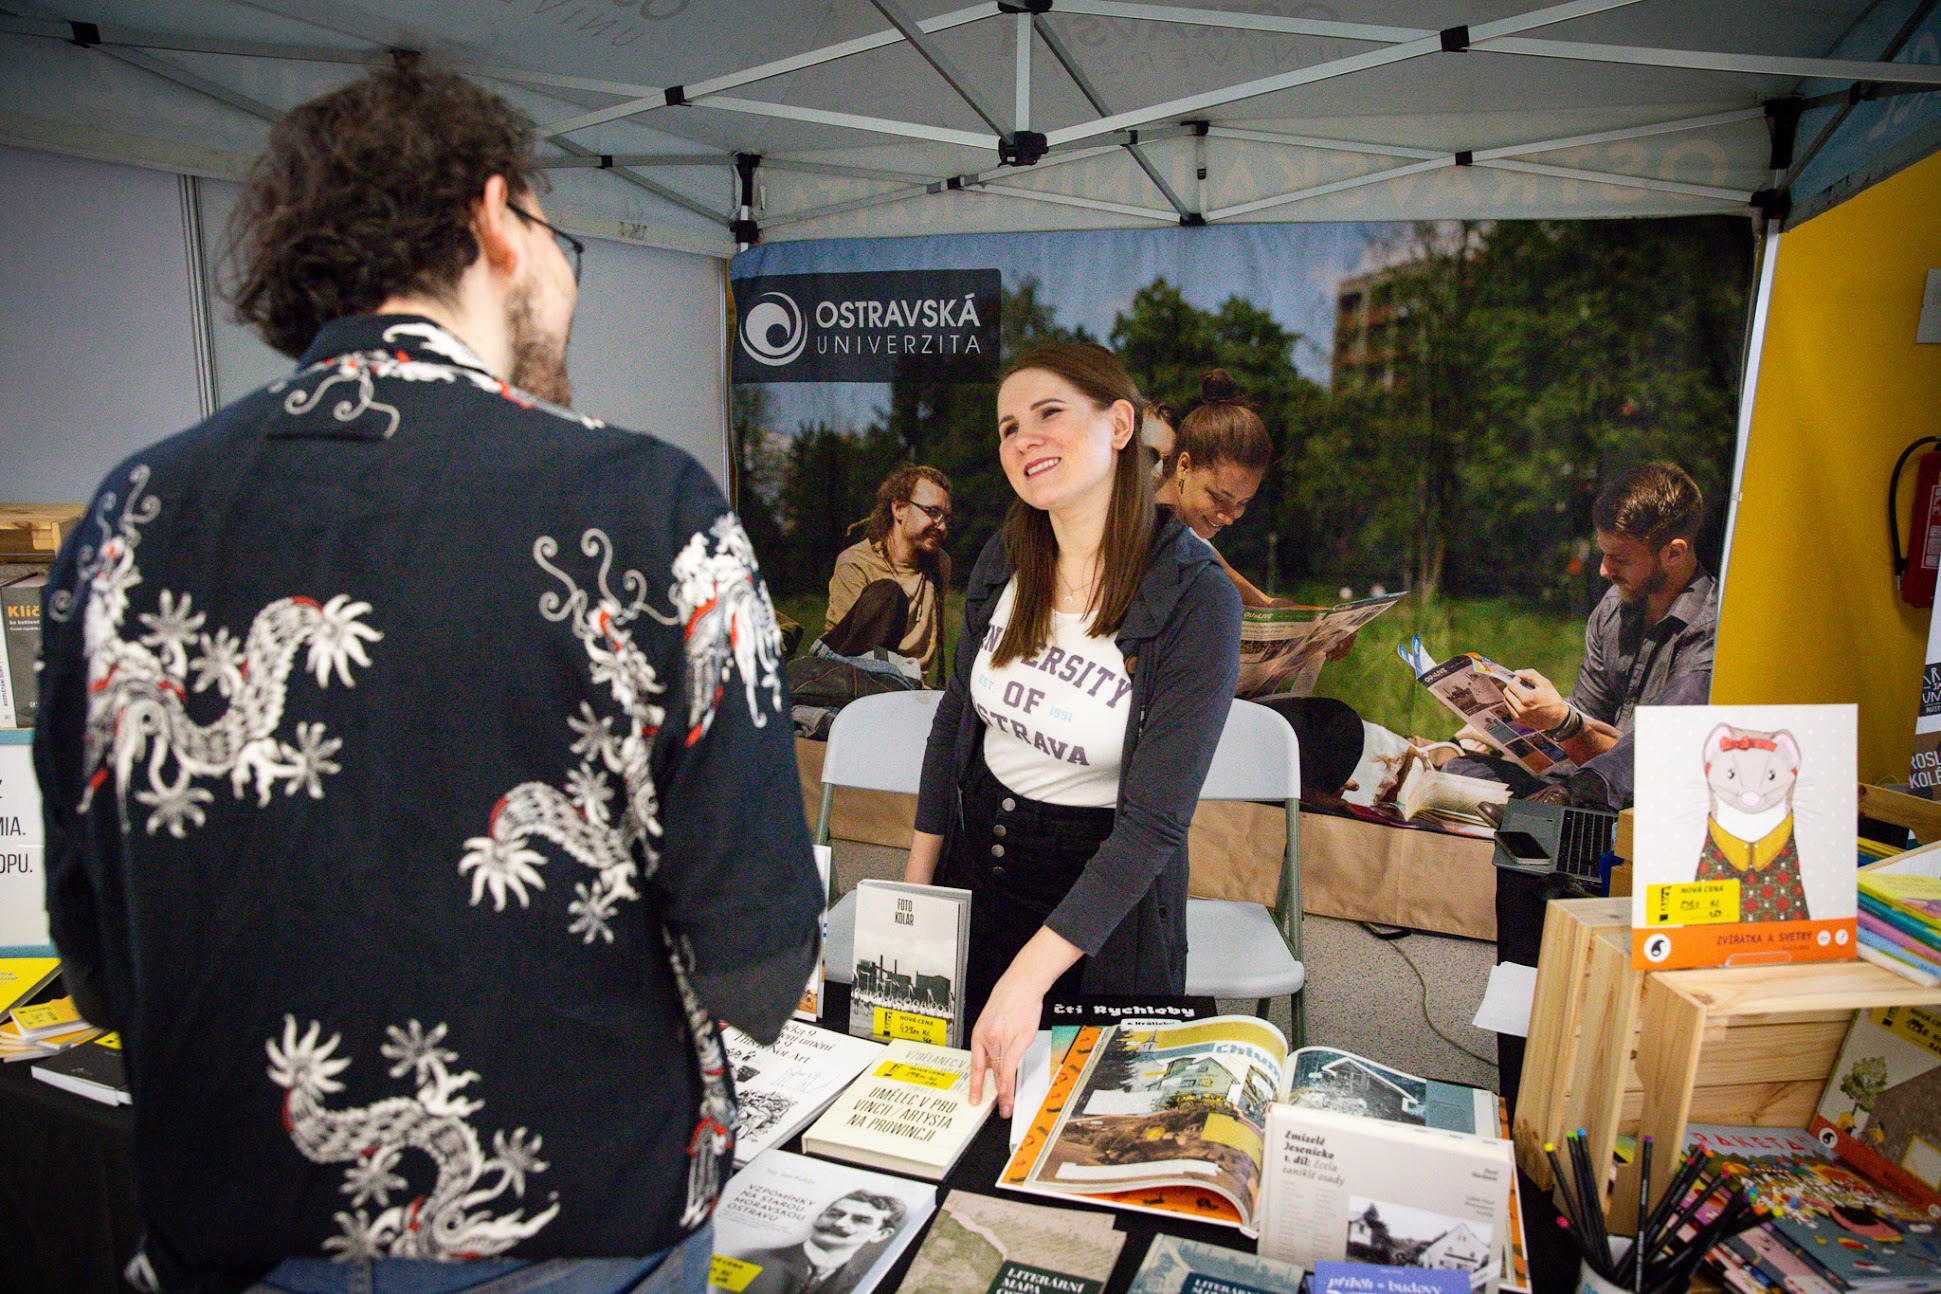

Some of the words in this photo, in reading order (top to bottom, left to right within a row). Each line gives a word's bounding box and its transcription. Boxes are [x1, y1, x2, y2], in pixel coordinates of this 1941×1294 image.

[815, 292, 981, 329] OSTRAVSKÁ
[817, 335, 981, 355] UNIVERZITA
[7, 605, 40, 618] Klíč
[1003, 680, 1046, 714] OF
[1050, 706, 1073, 723] 1991
[973, 702, 1090, 766] STRAVA
[1704, 885, 1723, 893] CENA
[897, 898, 913, 912] FOTO
[1767, 934, 1774, 942] A
[1778, 931, 1813, 942] SVETRY
[1053, 1003, 1083, 1014] Čti
[1093, 1005, 1196, 1017] Rychleby
[918, 1018, 934, 1026] CENA
[808, 1029, 817, 1037] 9
[791, 1052, 813, 1064] Art
[868, 1087, 919, 1106] UMĚLEC
[919, 1095, 931, 1108] V
[930, 1099, 958, 1114] PRO
[853, 1099, 894, 1117] VINCII
[899, 1108, 953, 1130] ARTYSTA
[847, 1114, 868, 1128] NA
[867, 1117, 936, 1143] PROWINCJI
[1285, 1130, 1325, 1146] Zmizelé
[1285, 1142, 1335, 1160] Jesenicko
[741, 1190, 756, 1199] NA
[761, 1195, 805, 1212] STAROU
[749, 1184, 816, 1206] VZPOMÍNKY
[727, 1202, 779, 1221] OSTRAVU
[734, 1196, 806, 1221] MORAVSKOU
